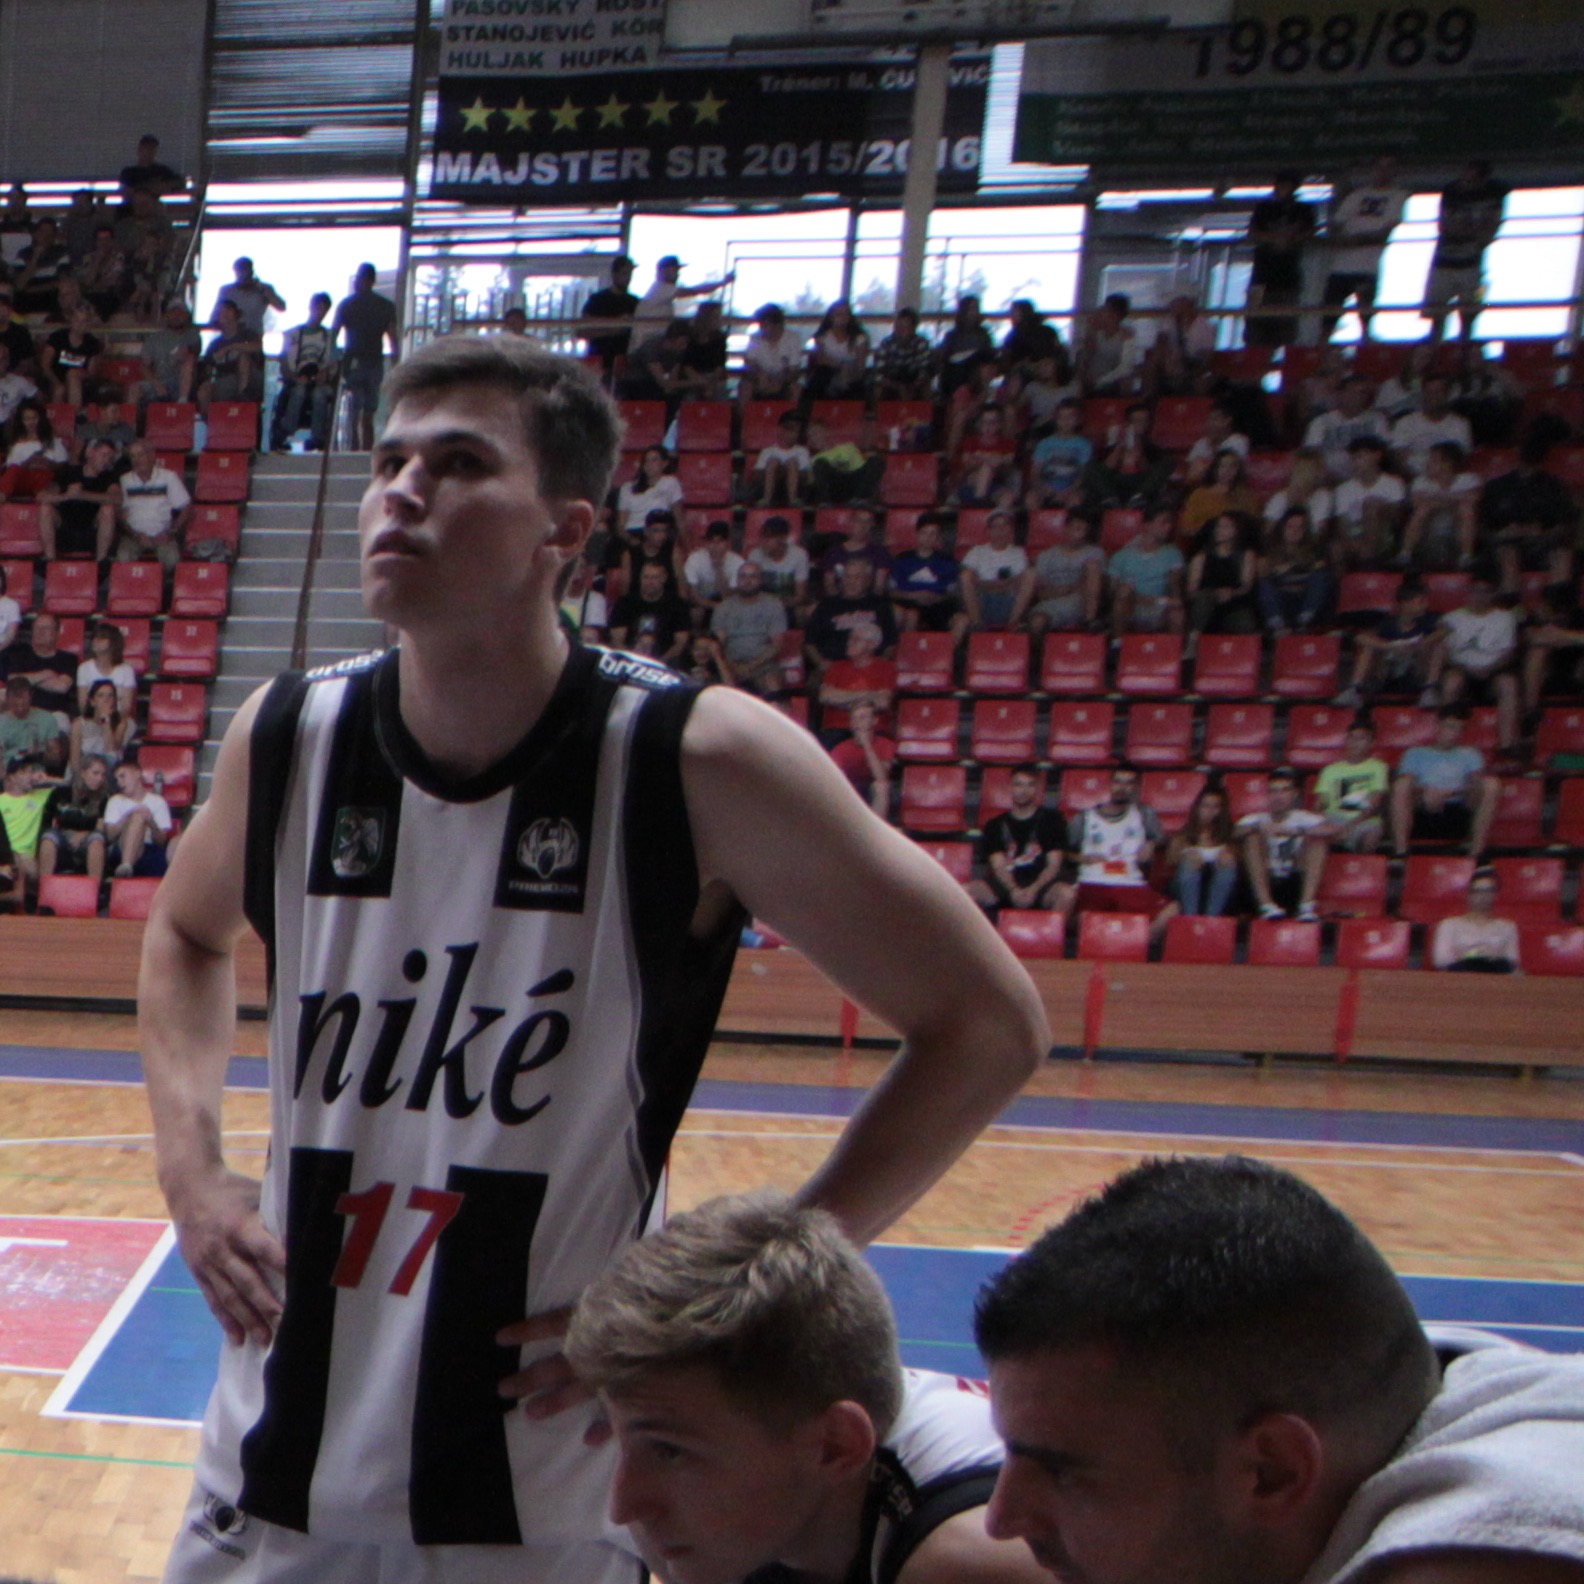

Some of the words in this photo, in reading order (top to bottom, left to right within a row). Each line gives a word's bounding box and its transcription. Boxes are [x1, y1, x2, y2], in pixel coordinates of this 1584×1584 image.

[448, 51, 545, 69] HULJAK
[560, 47, 648, 69] HUPKA
[1188, 7, 1477, 78] 1988/89
[435, 144, 650, 185] MAJSTER
[666, 145, 727, 180] SR
[598, 652, 682, 688] brose
[293, 942, 575, 1126] niké
[331, 1182, 465, 1295] 17
